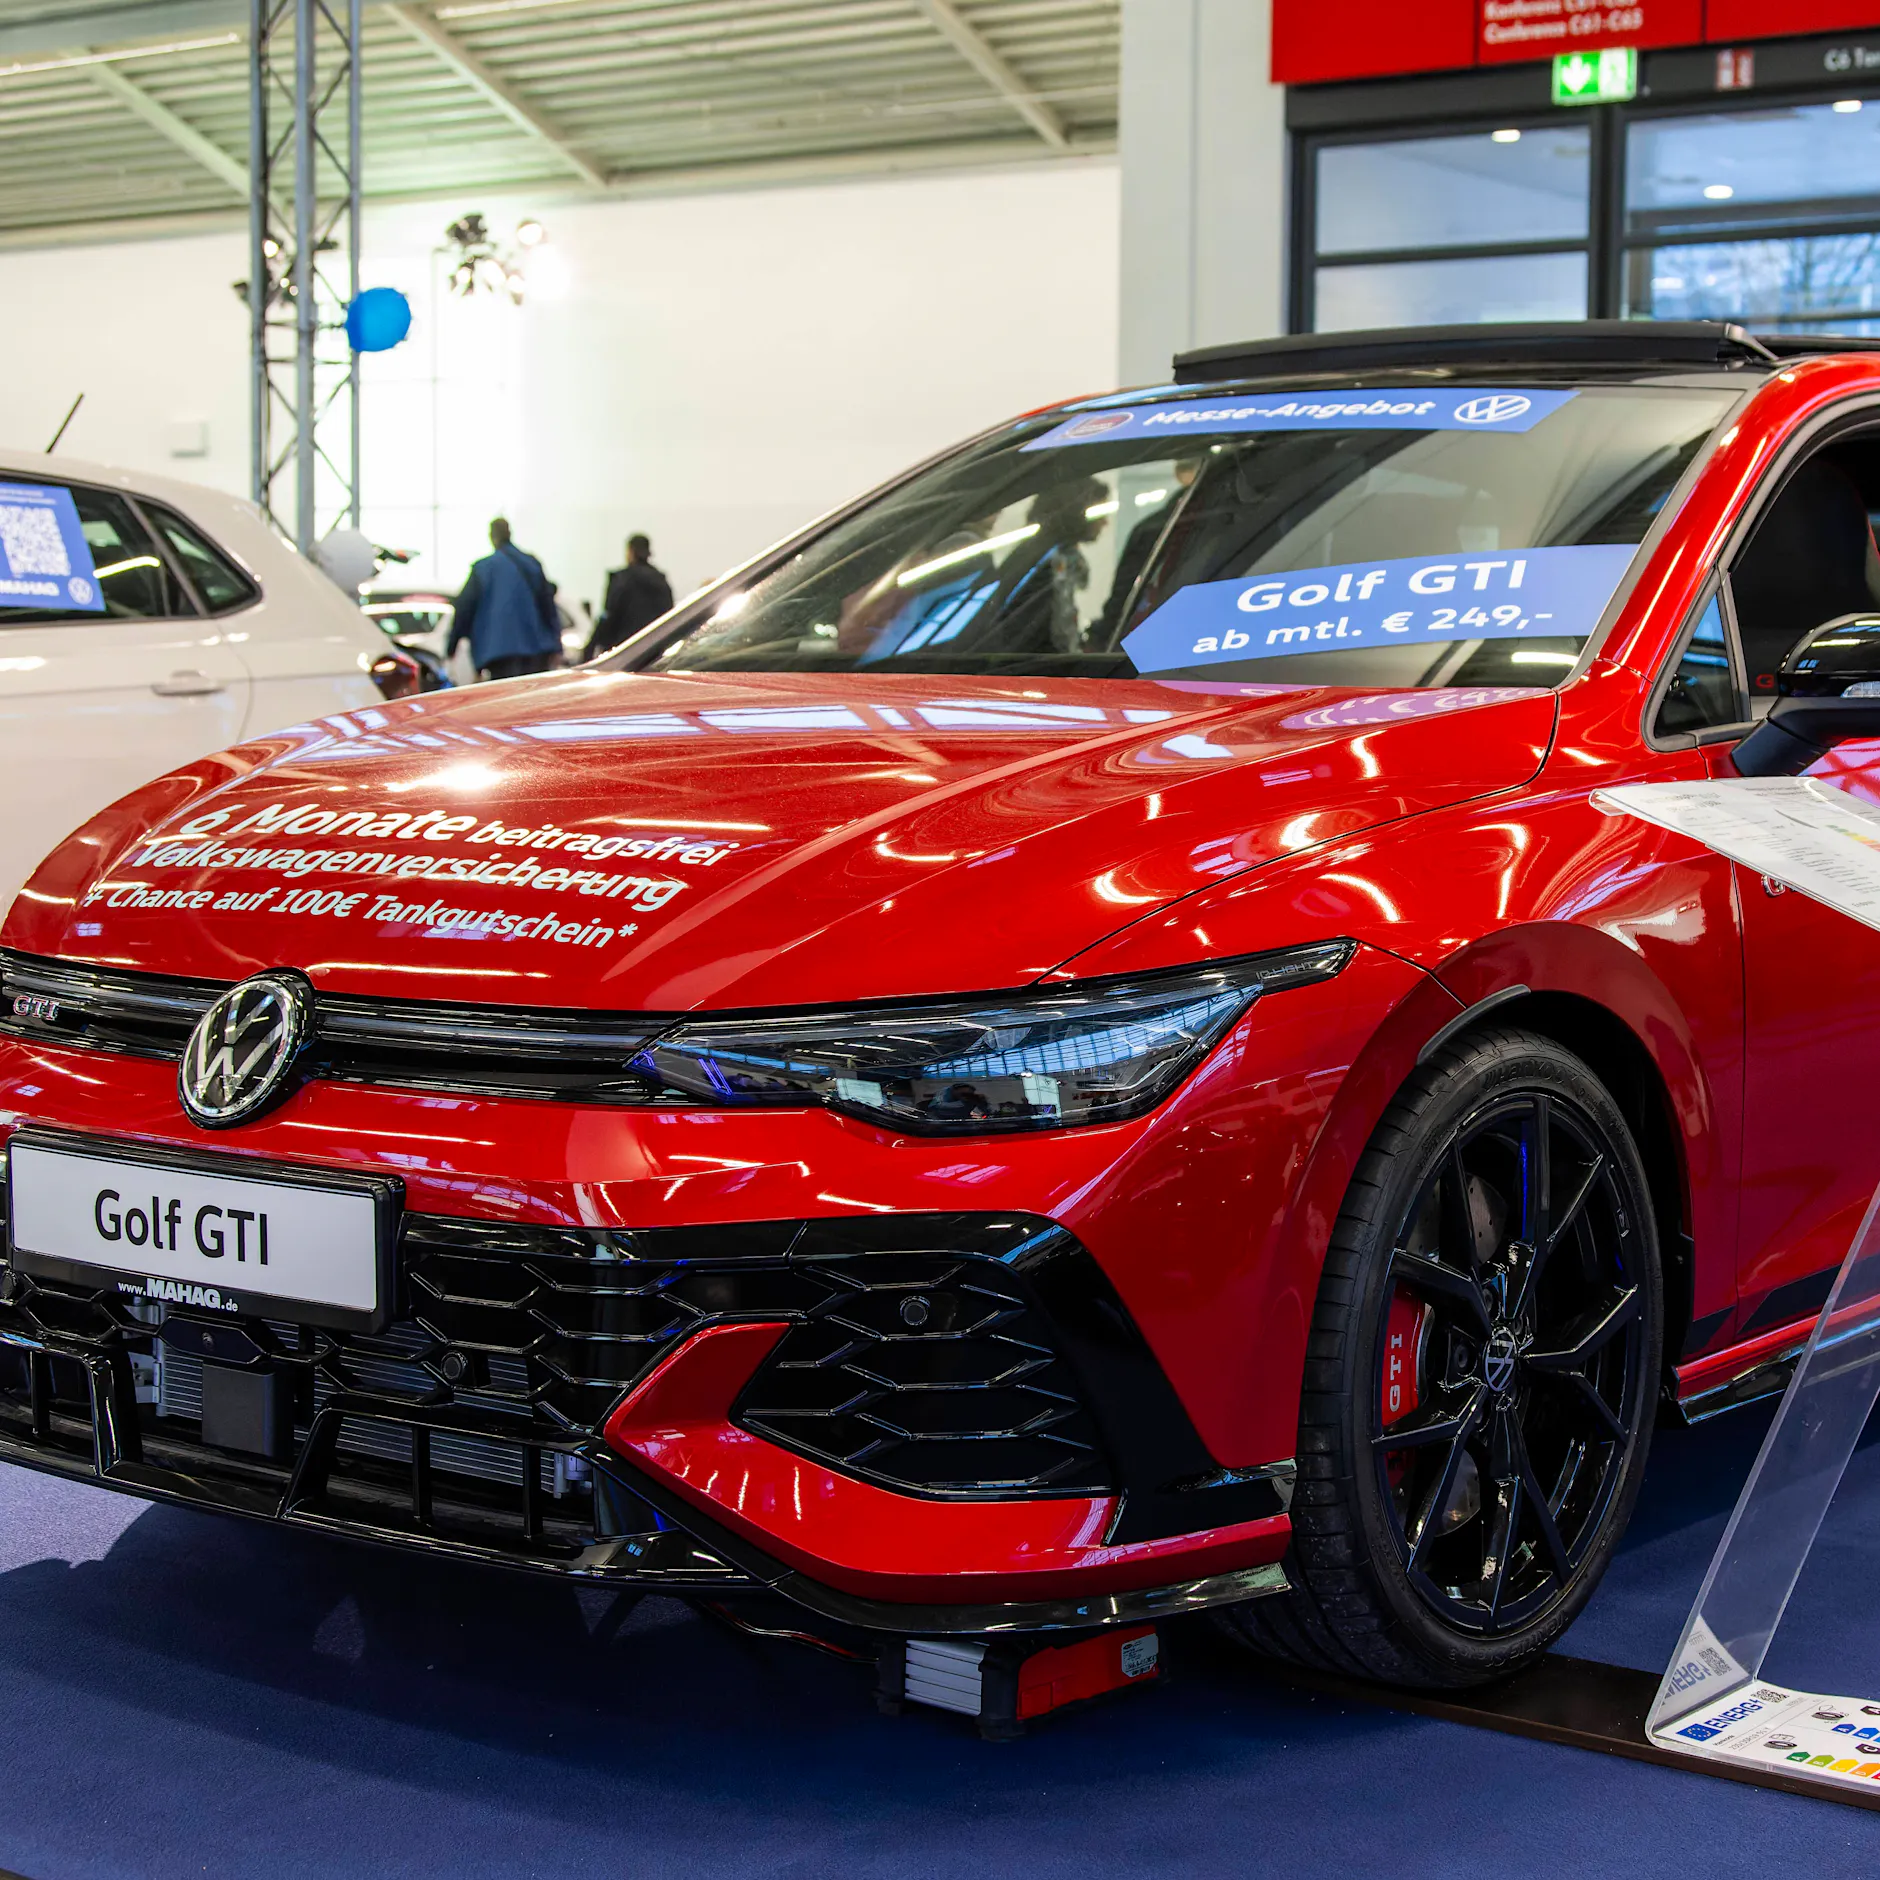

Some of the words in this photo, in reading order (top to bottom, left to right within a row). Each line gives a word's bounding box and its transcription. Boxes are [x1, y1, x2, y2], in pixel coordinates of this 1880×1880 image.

[1484, 20, 1567, 45] Conference
[1143, 399, 1436, 426] Messe-Angebot
[1236, 569, 1387, 613] Golf
[1408, 559, 1527, 595] GTI
[1192, 628, 1249, 654] ab
[1265, 616, 1362, 645] mtl.
[1381, 611, 1414, 633] €
[1427, 604, 1553, 631] 249,-
[179, 803, 246, 835] 6
[226, 803, 478, 841] Monate
[465, 820, 740, 867] beitragsfrei
[106, 884, 213, 910] Chance
[212, 886, 283, 912] auf
[269, 889, 369, 918] 100€
[132, 840, 687, 912] Volkswagenversicherung
[13, 995, 60, 1021] GTI
[94, 1189, 182, 1252] Golf
[194, 1204, 269, 1266] GTI
[117, 1278, 239, 1312] www.MAHAG.de
[1389, 1333, 1403, 1413] GTI
